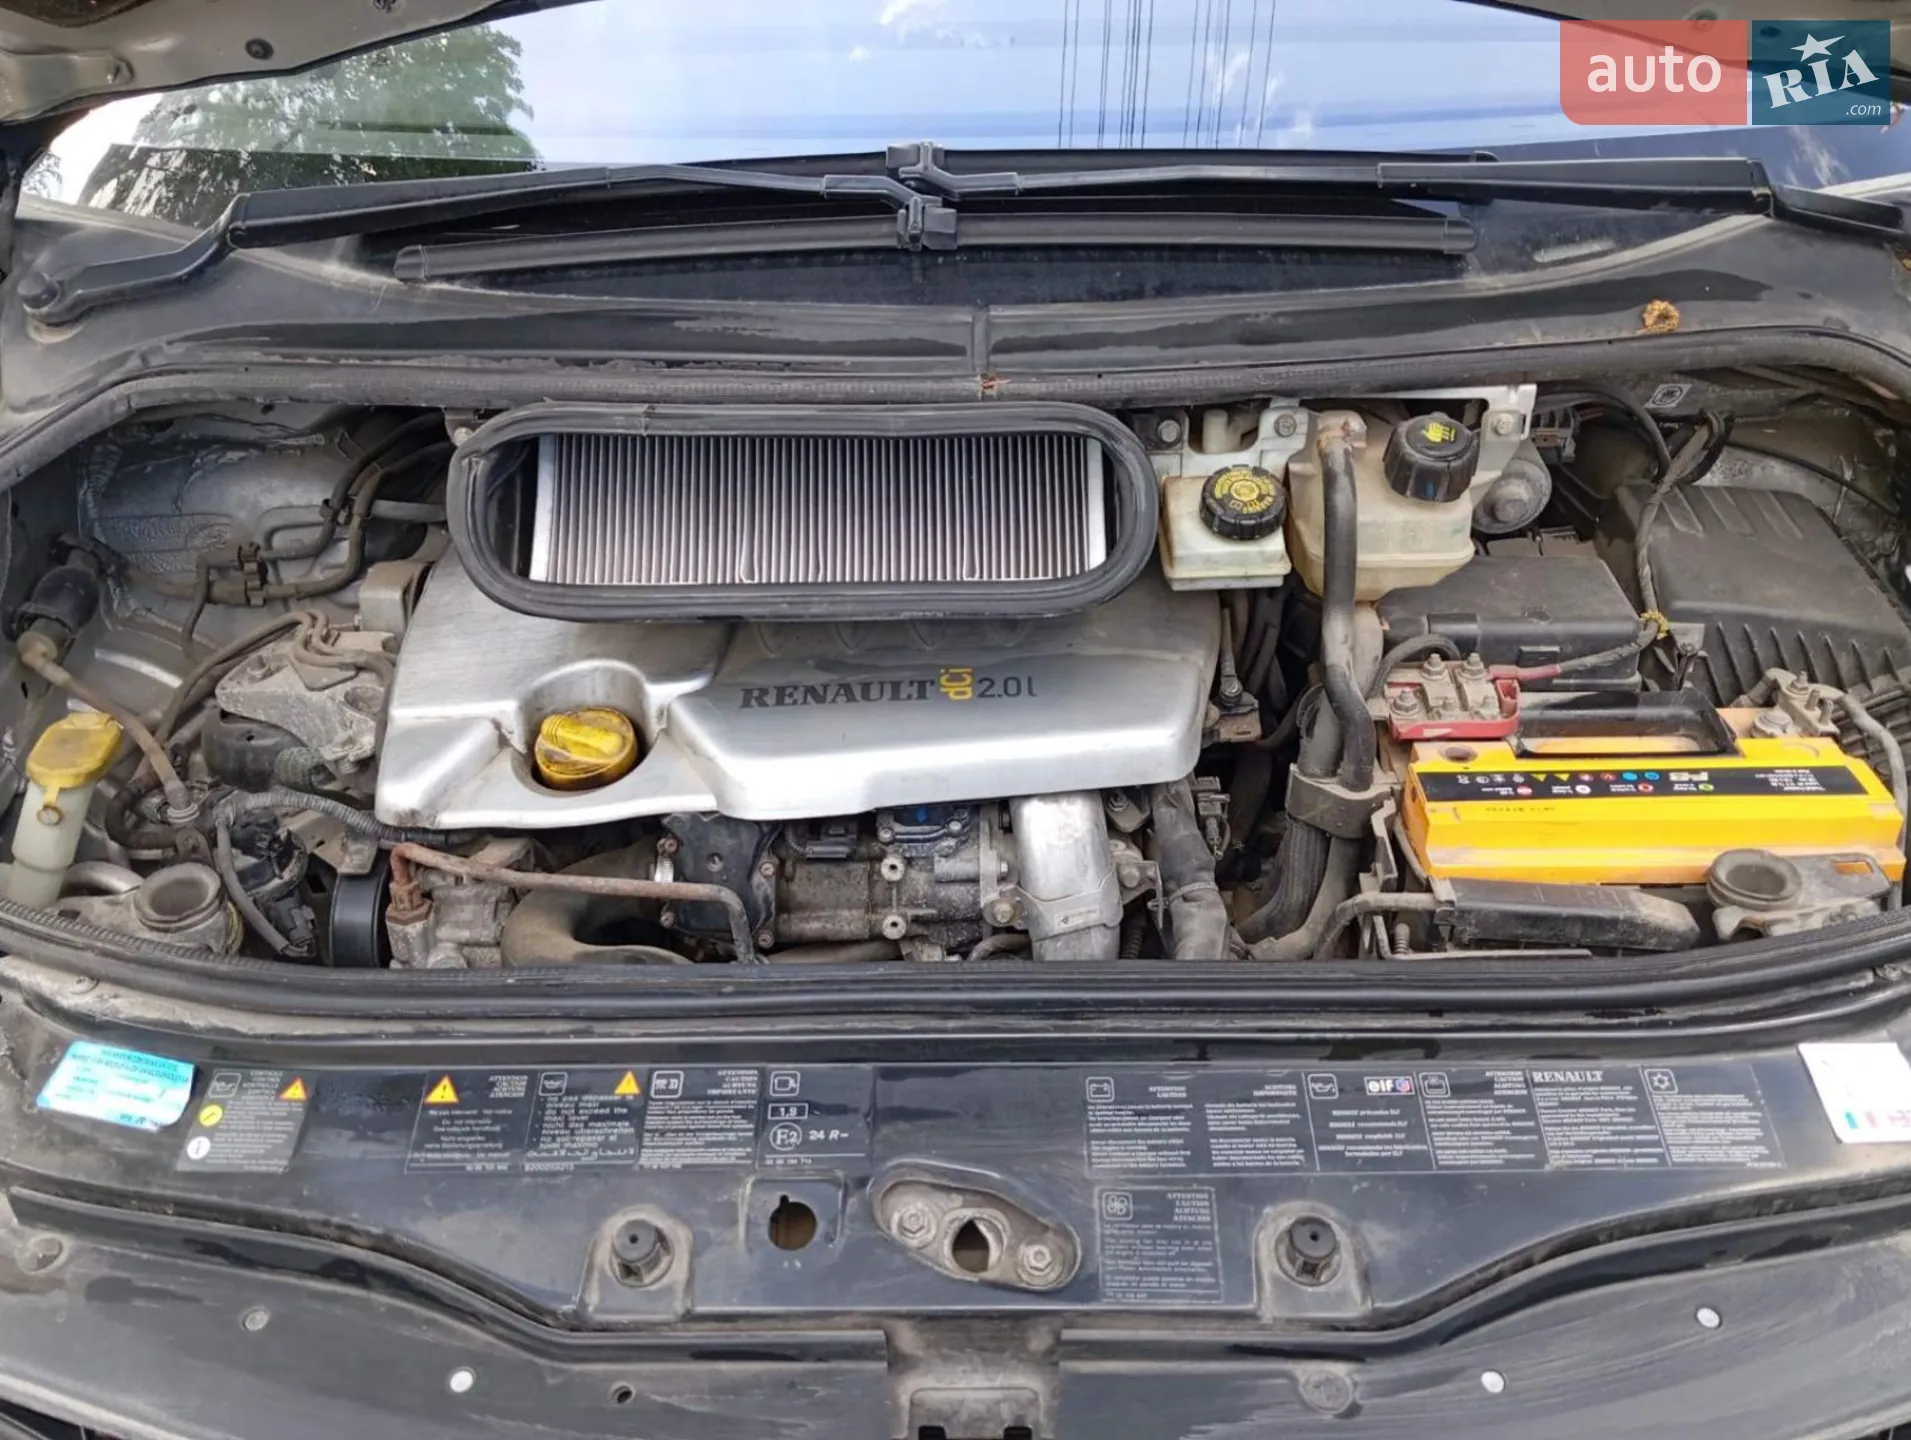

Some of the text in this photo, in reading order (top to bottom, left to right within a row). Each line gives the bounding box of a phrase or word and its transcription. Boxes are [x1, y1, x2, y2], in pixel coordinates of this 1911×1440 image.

[740, 679, 935, 709] RENAULT
[1532, 1071, 1603, 1082] RENAULT
[1368, 1080, 1394, 1092] elf
[809, 1130, 825, 1140] 24
